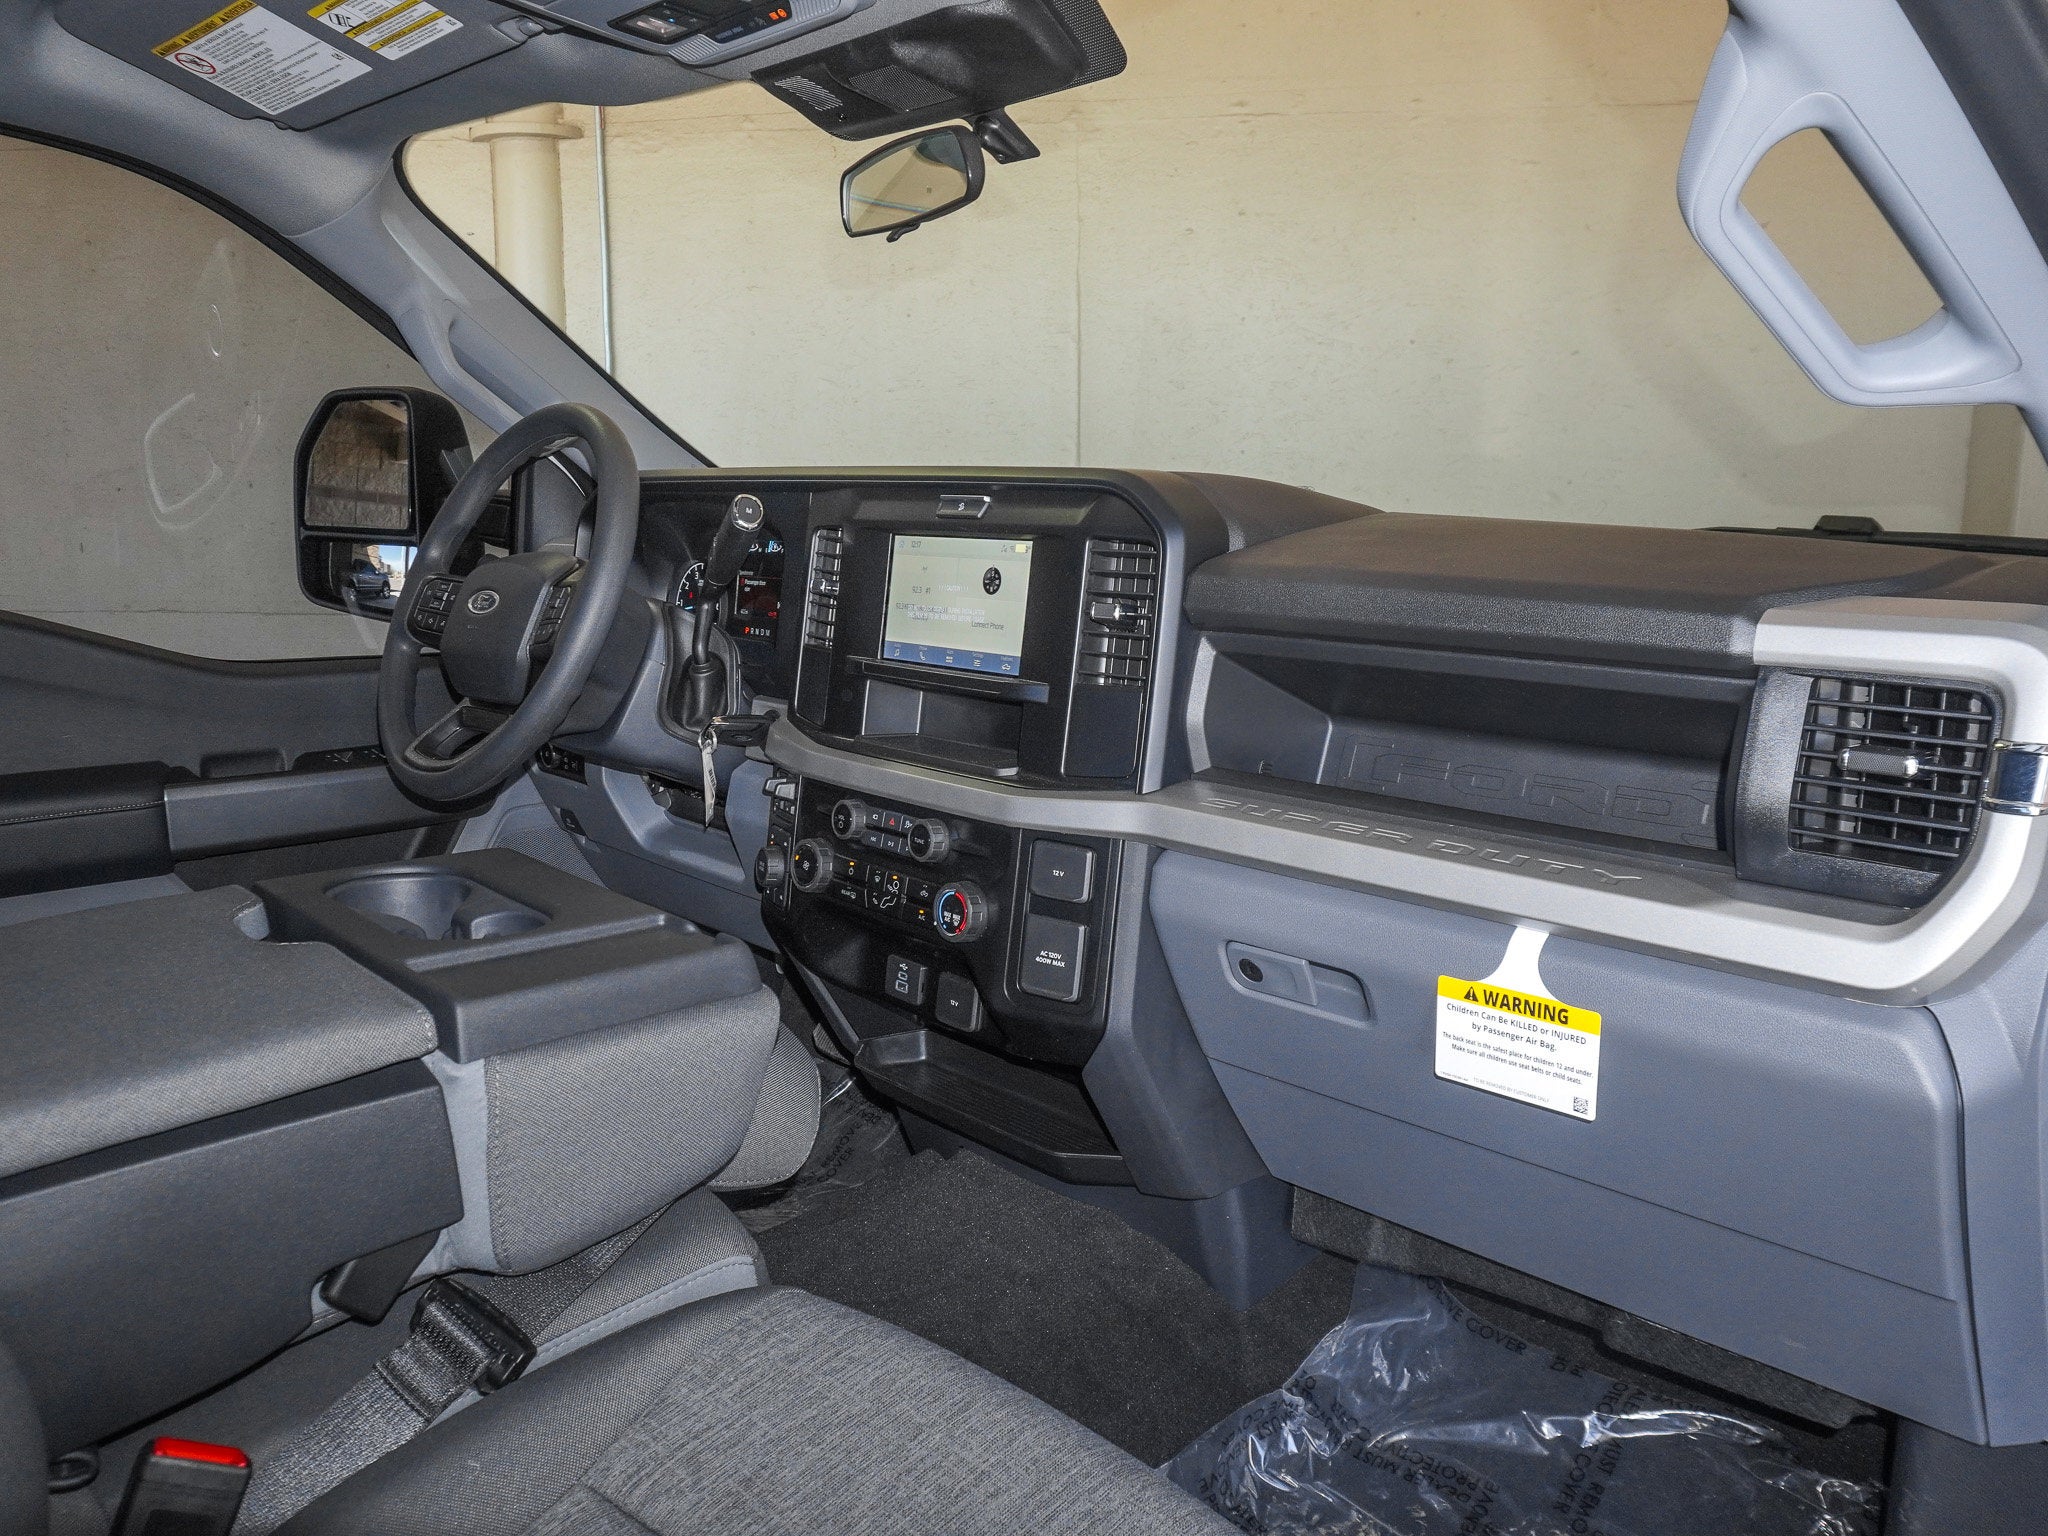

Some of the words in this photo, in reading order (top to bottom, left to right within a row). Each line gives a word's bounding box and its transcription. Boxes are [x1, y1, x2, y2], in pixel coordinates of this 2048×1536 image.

[685, 581, 690, 590] 2
[694, 572, 699, 580] 3
[744, 626, 750, 634] P
[1200, 798, 1413, 844] SUPER
[1426, 838, 1643, 886] DUTY
[1035, 956, 1052, 965] 400W
[1052, 959, 1066, 968] MAX
[1039, 950, 1049, 958] AC
[1048, 951, 1062, 960] 120V
[1446, 1003, 1479, 1018] Children
[1481, 1011, 1497, 1022] Can
[1498, 1016, 1509, 1025] Be
[1510, 1019, 1538, 1033] KILLED
[1540, 1028, 1549, 1036] or
[1551, 1030, 1587, 1046] INJURED
[1483, 989, 1569, 1025] WARNING
[1442, 1031, 1452, 1039] The
[1452, 1034, 1465, 1043] back
[1465, 1037, 1477, 1046] seat
[1482, 1042, 1492, 1050] the
[1492, 1044, 1508, 1055] safest
[1508, 1048, 1523, 1059] place
[1523, 1053, 1532, 1061] for
[1533, 1055, 1555, 1067] children
[1556, 1062, 1563, 1070] 12
[1563, 1064, 1575, 1073] and
[1575, 1068, 1594, 1079] under.
[1471, 1022, 1482, 1032] by
[1483, 1025, 1524, 1042] Passenger
[1525, 1035, 1538, 1046] Air
[1540, 1039, 1558, 1052] Bag.
[1451, 1044, 1466, 1053] Make
[1466, 1048, 1478, 1056] sure
[1478, 1050, 1486, 1058] all
[1486, 1052, 1508, 1064] children
[1508, 1059, 1518, 1067] use
[1518, 1061, 1530, 1070] seat
[1531, 1064, 1545, 1075] belts
[1552, 1070, 1566, 1081] child
[1566, 1075, 1583, 1086] seats.
[1466, 1316, 1527, 1356] COVER
[1353, 1449, 1400, 1475] MUST
[1553, 1453, 1592, 1514] COVER
[1571, 1481, 1606, 1535] REMO
